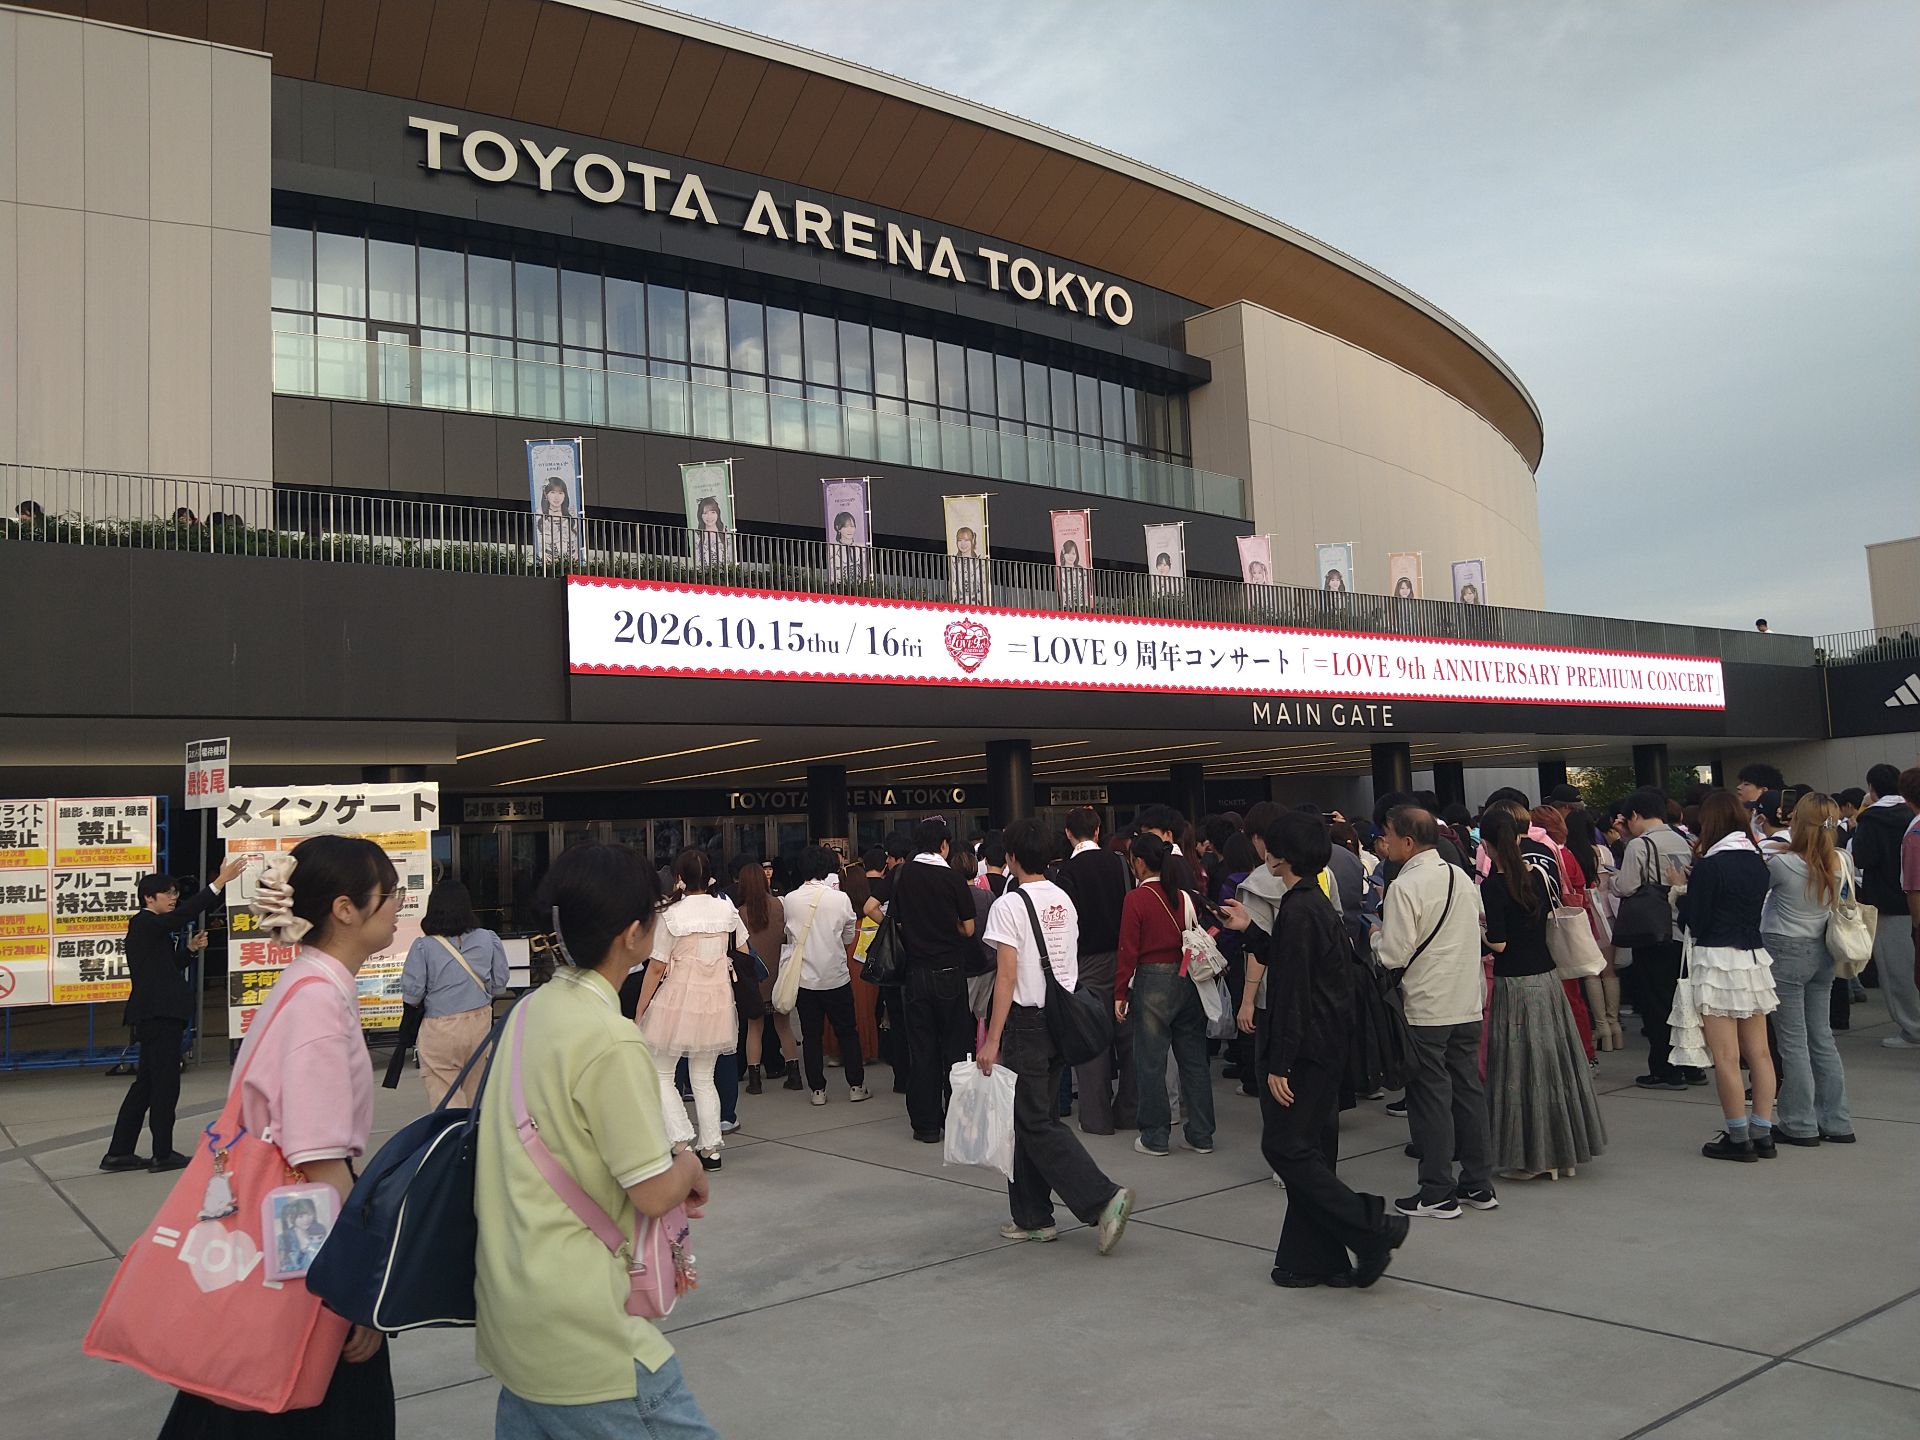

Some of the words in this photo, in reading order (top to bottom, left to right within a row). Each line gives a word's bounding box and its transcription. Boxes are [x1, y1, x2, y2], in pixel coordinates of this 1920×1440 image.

[408, 116, 718, 225] TOYOTA
[743, 190, 966, 282] ARENA
[978, 246, 1133, 326] TOKYO
[866, 625, 923, 658] 16fri
[1397, 651, 1426, 680] 9th
[1432, 657, 1560, 687] ANNIVERSARY
[1566, 664, 1644, 690] PREMIUM
[1253, 701, 1320, 727] MAIN
[1332, 704, 1394, 728] GATE
[188, 768, 225, 796] 最後尾
[902, 787, 966, 805] TOKYO
[0, 804, 43, 816] ライト
[0, 817, 43, 828] ライト
[60, 806, 148, 818] 撮影・録画・録音
[222, 793, 436, 828] メインゲート
[78, 820, 132, 846] 禁止
[240, 942, 302, 966] 実施
[79, 957, 131, 982] 禁止
